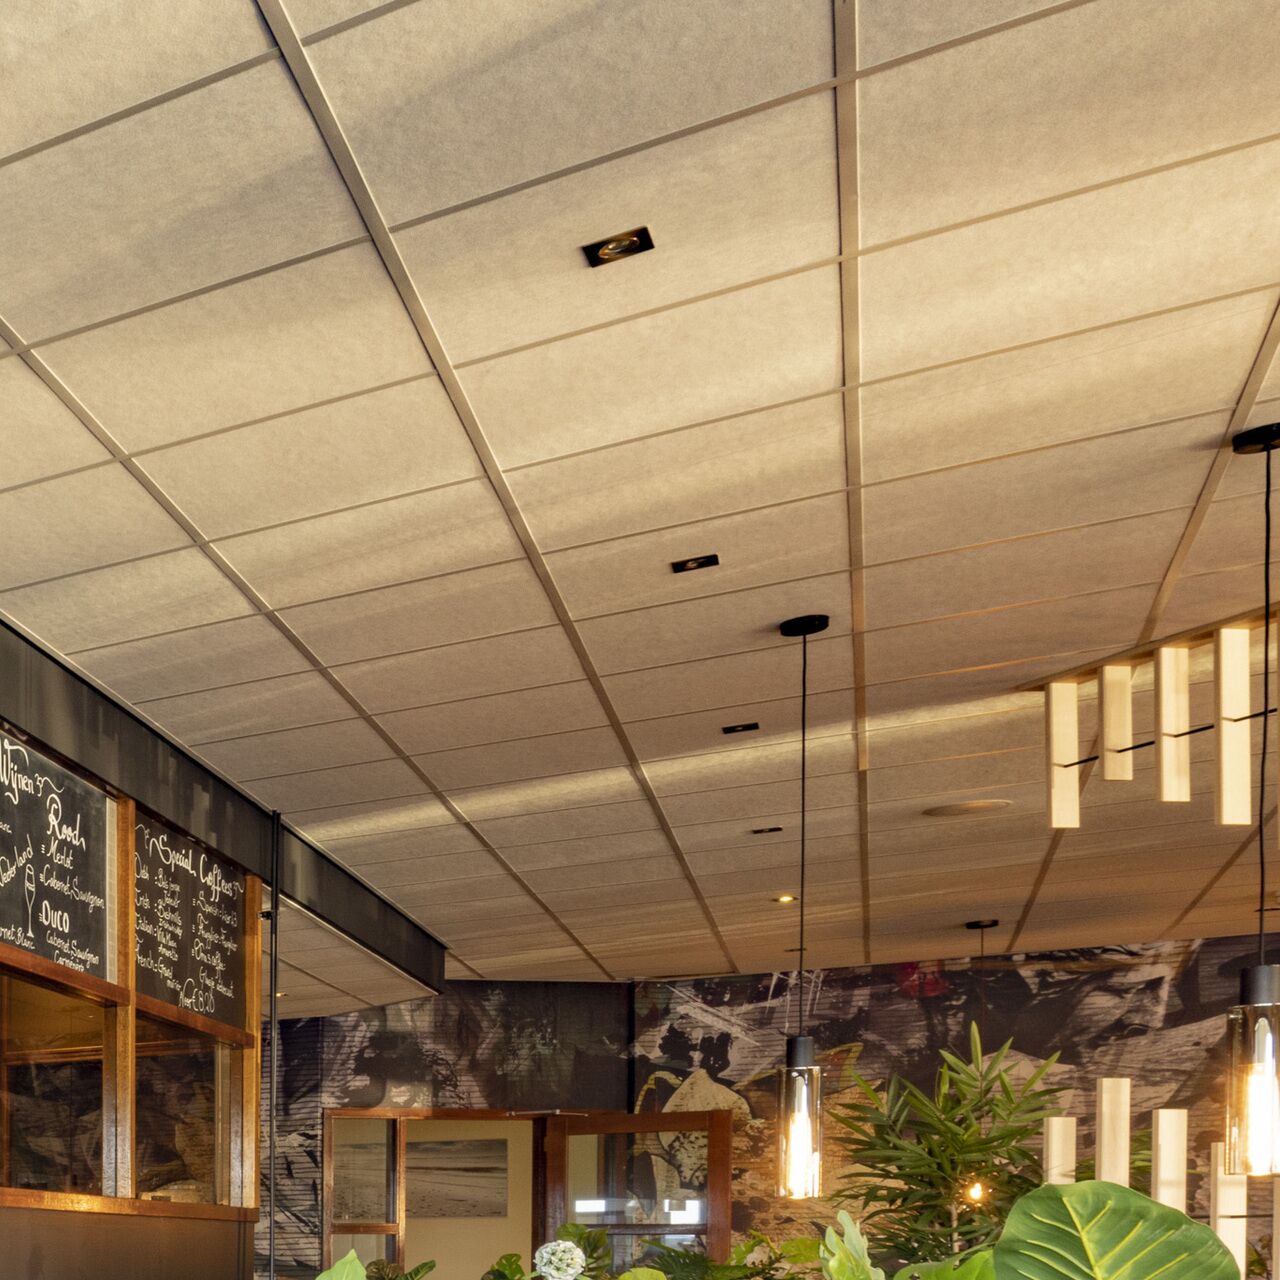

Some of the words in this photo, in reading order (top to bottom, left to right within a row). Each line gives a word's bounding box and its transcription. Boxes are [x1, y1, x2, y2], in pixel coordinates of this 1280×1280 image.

[46, 794, 85, 850] Rood
[149, 833, 197, 873] Special
[200, 853, 233, 902] Coffees
